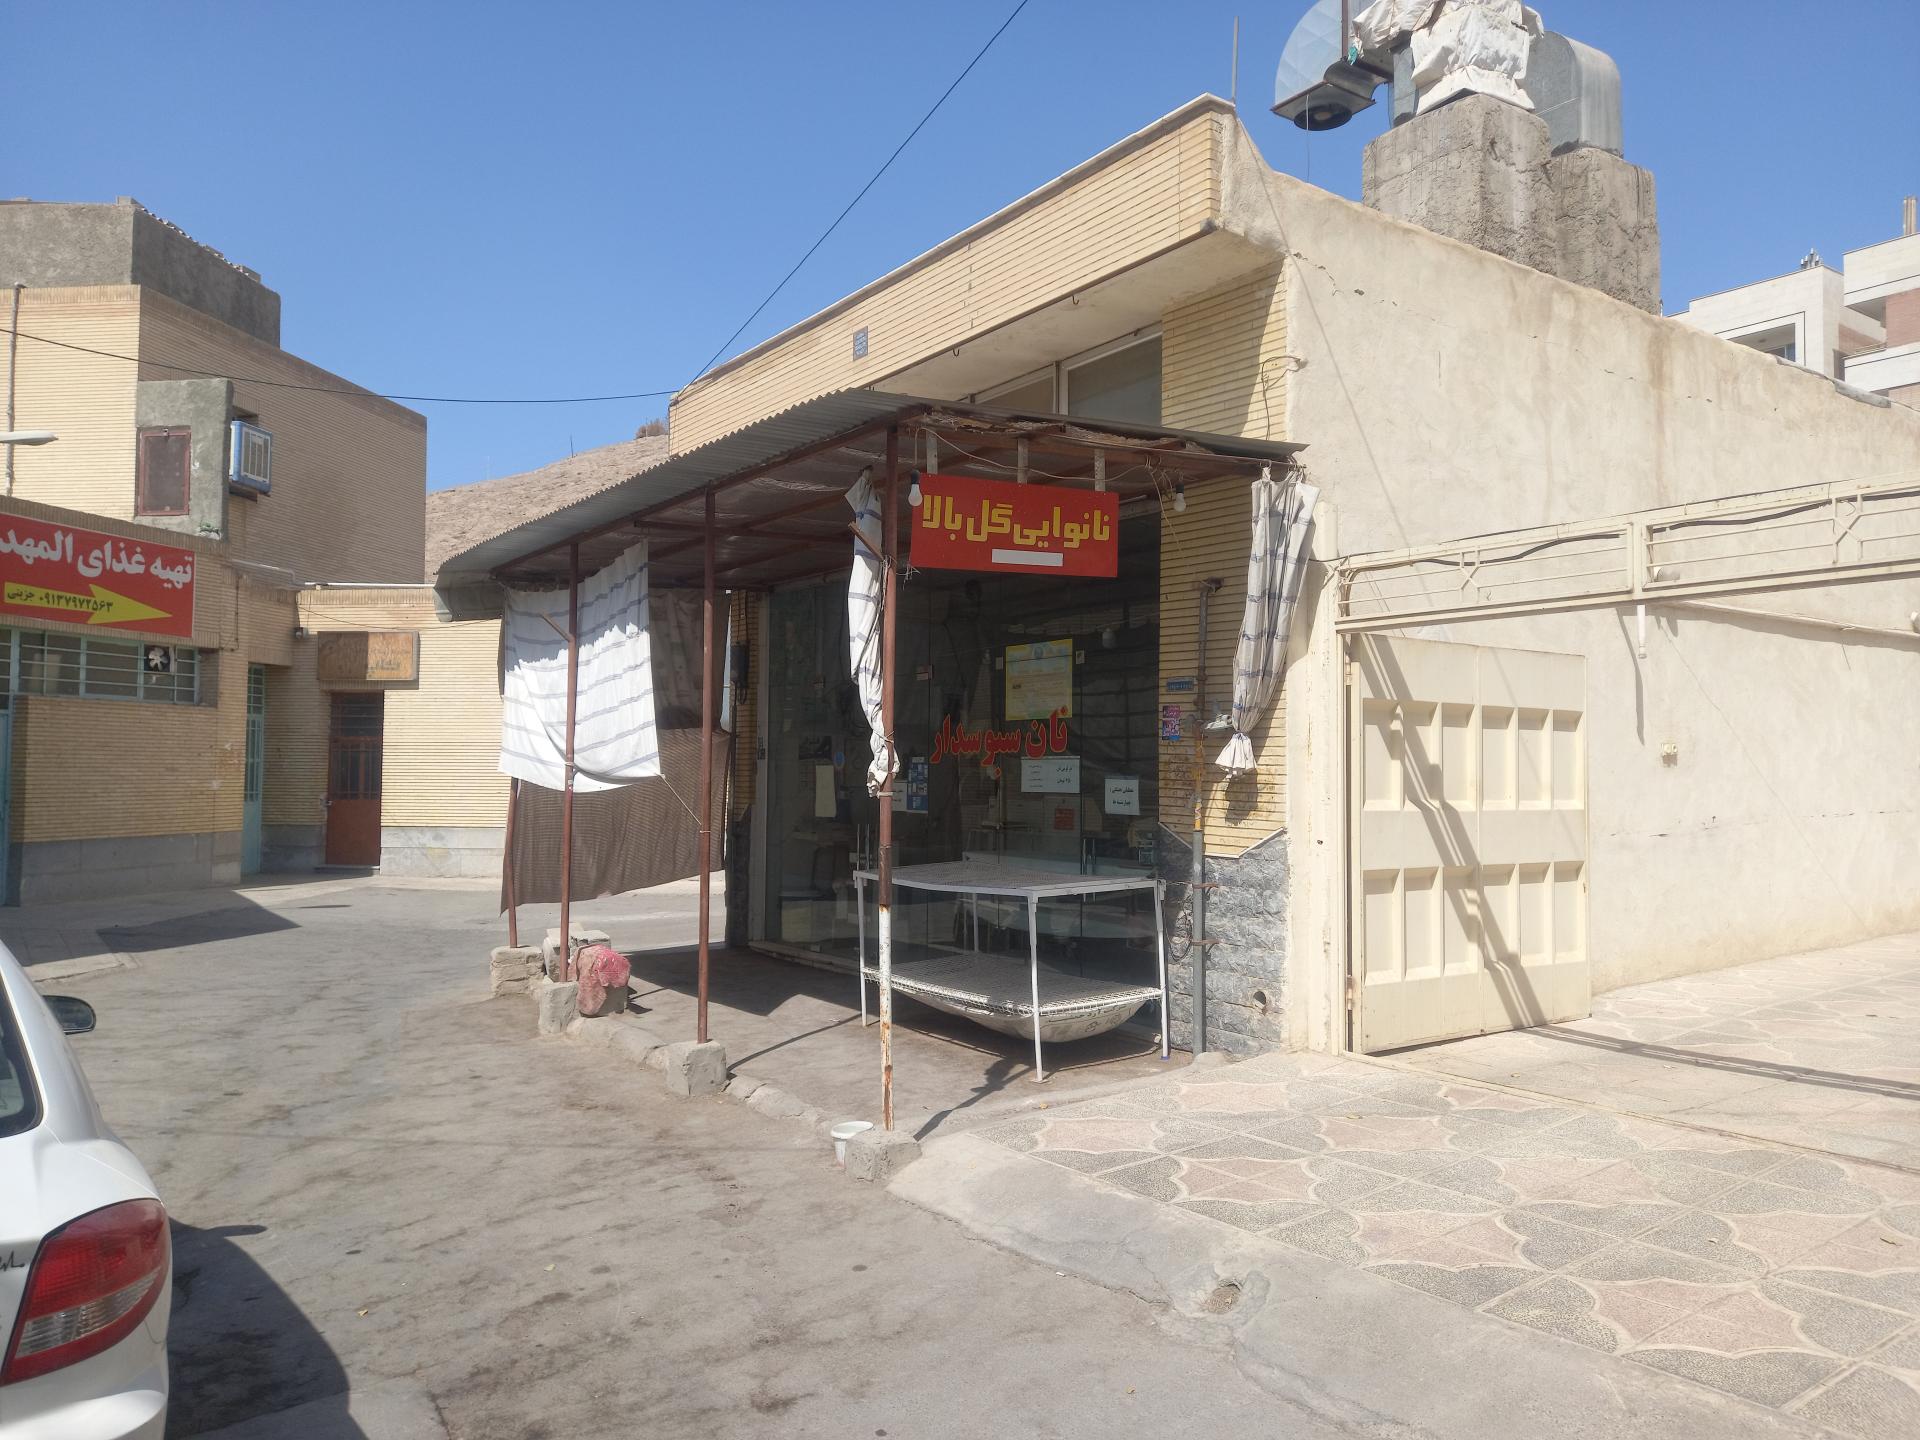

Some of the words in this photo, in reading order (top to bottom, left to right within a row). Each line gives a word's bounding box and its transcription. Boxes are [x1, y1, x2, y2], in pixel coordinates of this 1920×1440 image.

[922, 494, 962, 541] بالا
[966, 499, 1013, 542] گل
[1013, 506, 1110, 548] نانوایی
[0, 529, 74, 565] المهد
[77, 541, 146, 578] غذای
[150, 555, 192, 589] تهیه
[1025, 705, 1068, 760] نان
